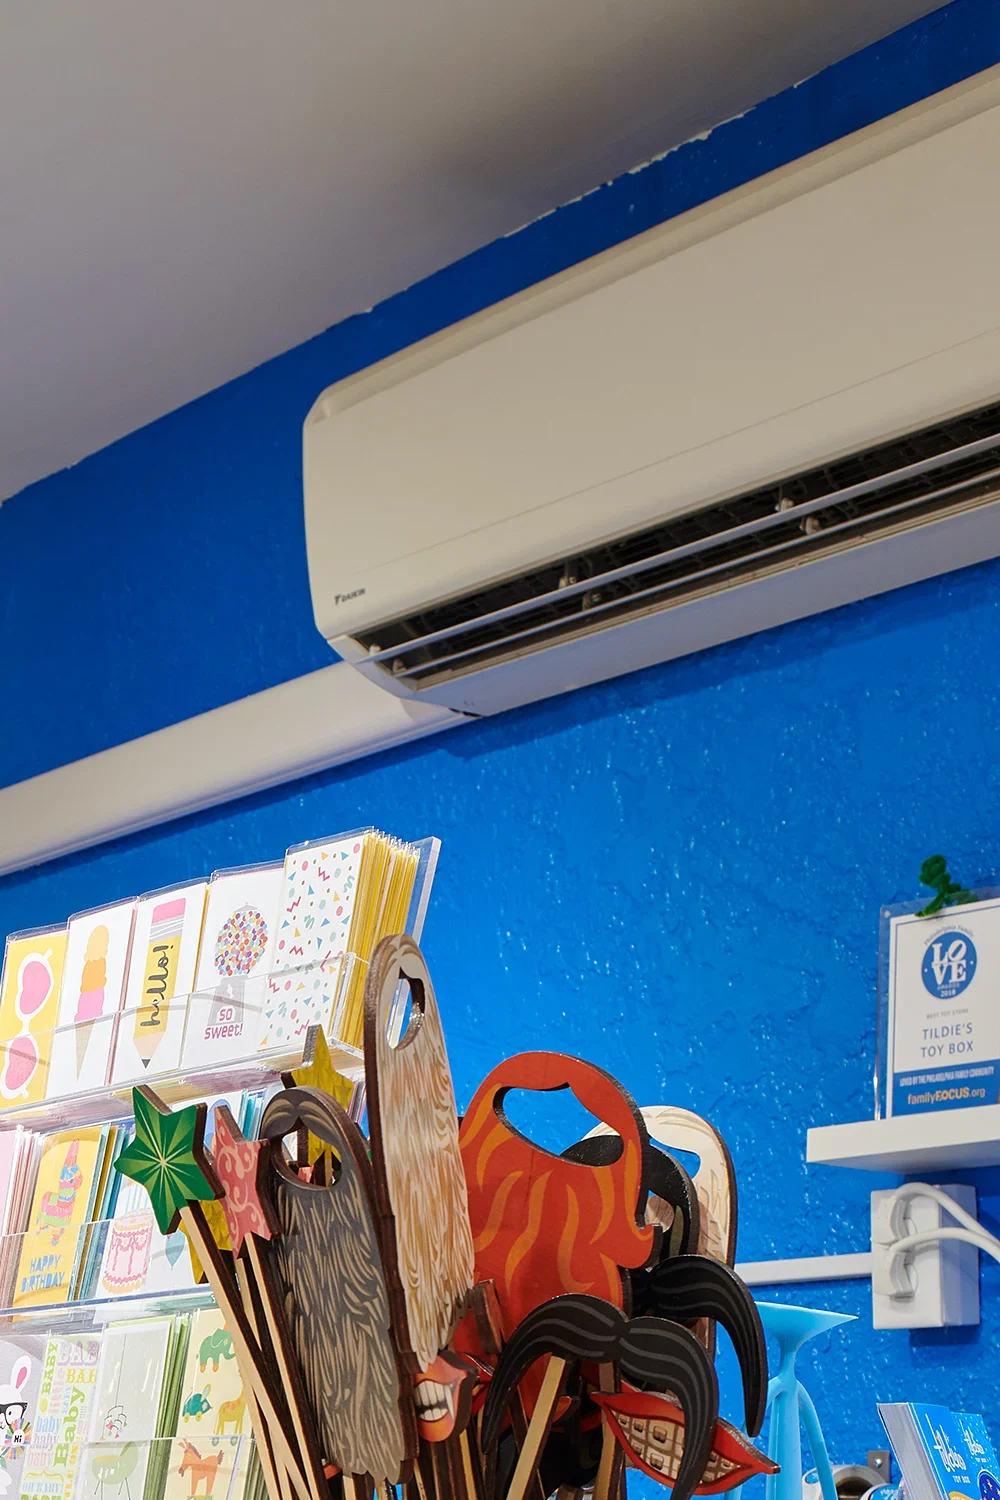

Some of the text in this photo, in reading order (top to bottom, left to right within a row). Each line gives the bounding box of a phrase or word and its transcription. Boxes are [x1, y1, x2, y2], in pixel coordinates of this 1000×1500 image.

[204, 1023, 244, 1041] sweet!
[922, 1022, 973, 1040] TILDIE'S
[921, 1040, 974, 1058] TOY BOX
[907, 1087, 986, 1105] familyFOCUS.org
[29, 1254, 62, 1273] HAPPY
[21, 1271, 66, 1292] BIRTHDAY
[53, 1386, 86, 1468] Baby
[13, 1434, 23, 1443] Hi
